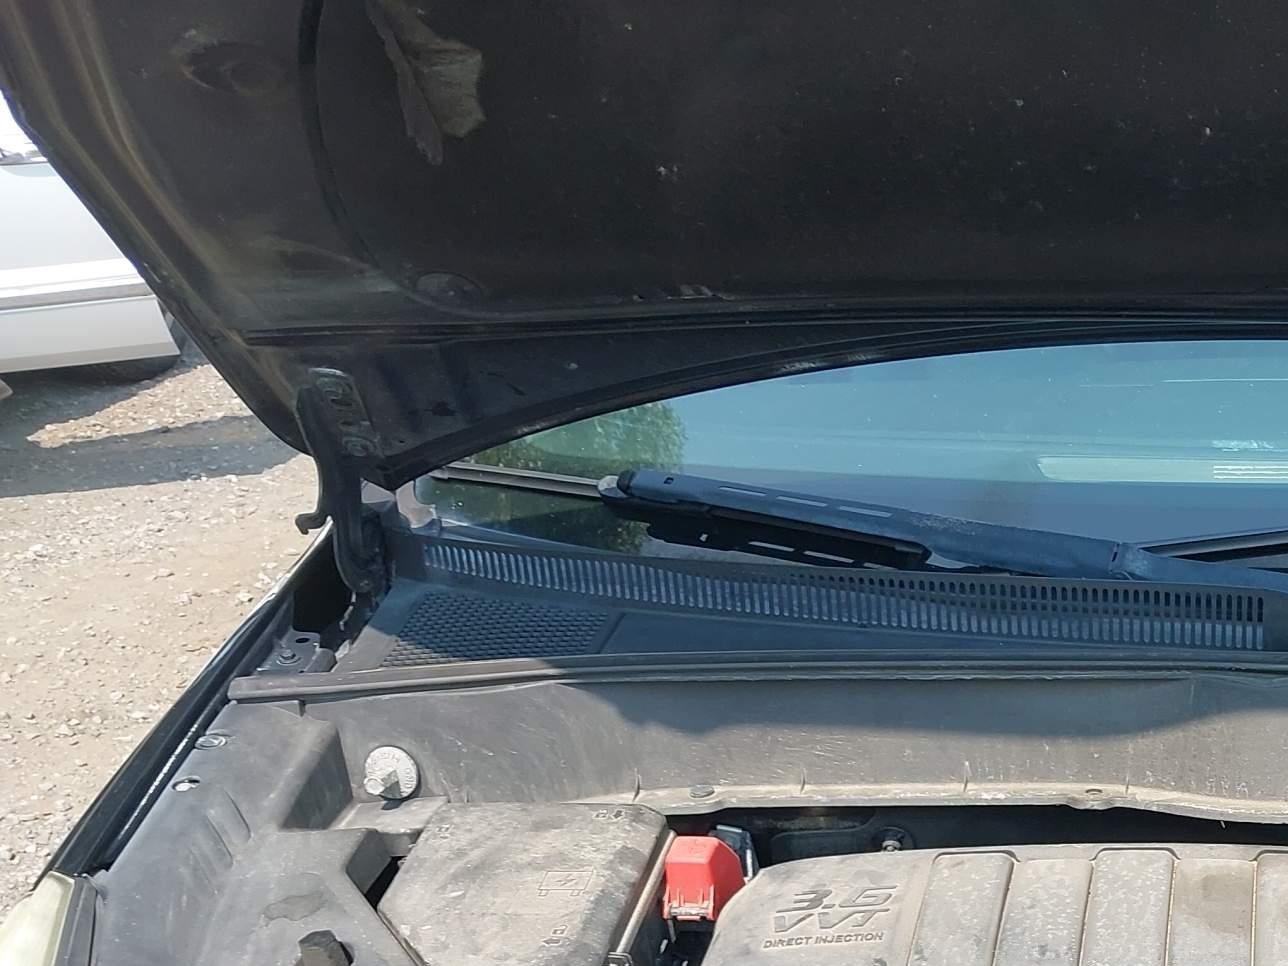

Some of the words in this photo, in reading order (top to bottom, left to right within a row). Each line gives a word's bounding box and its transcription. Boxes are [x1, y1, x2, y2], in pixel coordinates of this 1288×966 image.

[776, 884, 898, 913] 3.6
[774, 908, 891, 933] VVT
[763, 936, 812, 949] DIRECT
[814, 932, 884, 945] INJECTION
